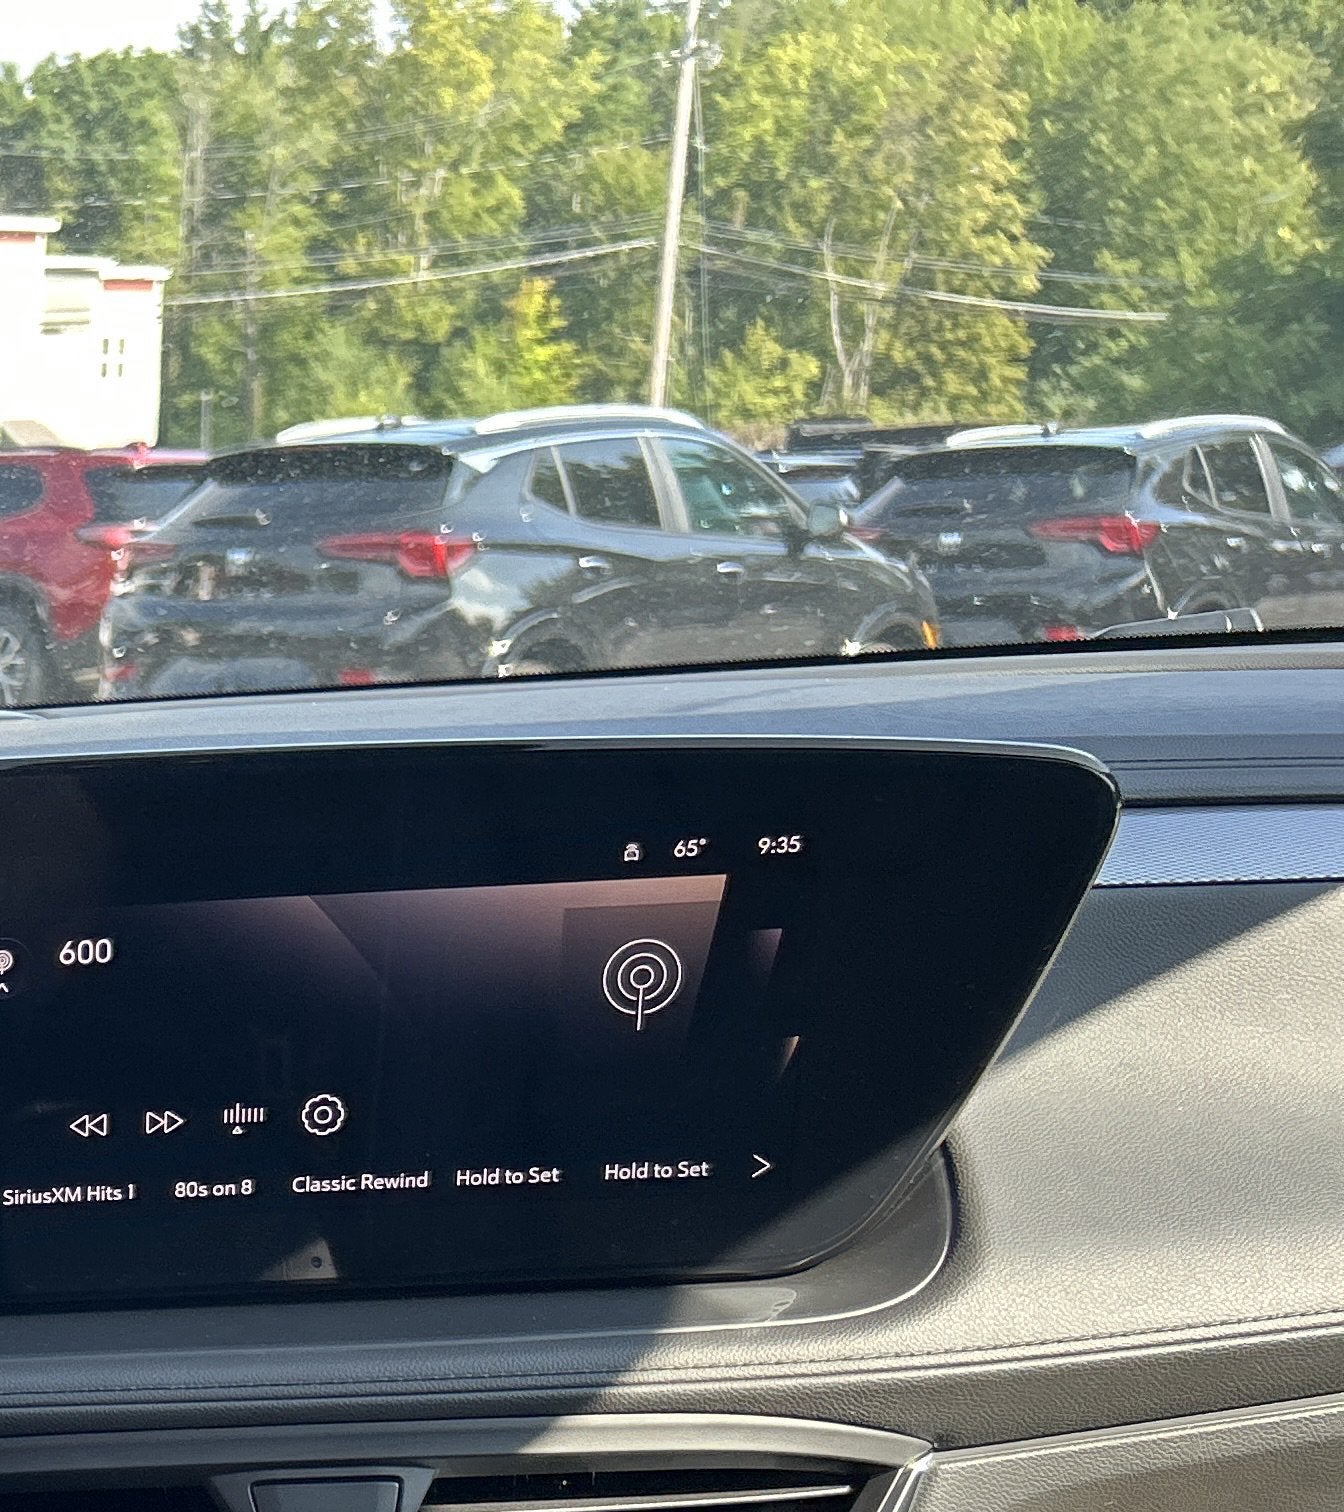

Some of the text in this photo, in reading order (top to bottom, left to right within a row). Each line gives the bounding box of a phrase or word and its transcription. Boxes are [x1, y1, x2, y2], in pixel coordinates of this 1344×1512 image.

[673, 838, 707, 858] 65°
[758, 835, 802, 855] 9:35
[59, 938, 113, 965] 600
[455, 1166, 561, 1187] Hold to Set
[604, 1160, 710, 1181] Hold to Set
[174, 1178, 254, 1199] 80s on 8
[291, 1171, 430, 1194] Classic Rewind
[2, 1186, 82, 1206] SiriusXM
[86, 1184, 122, 1202] Hits
